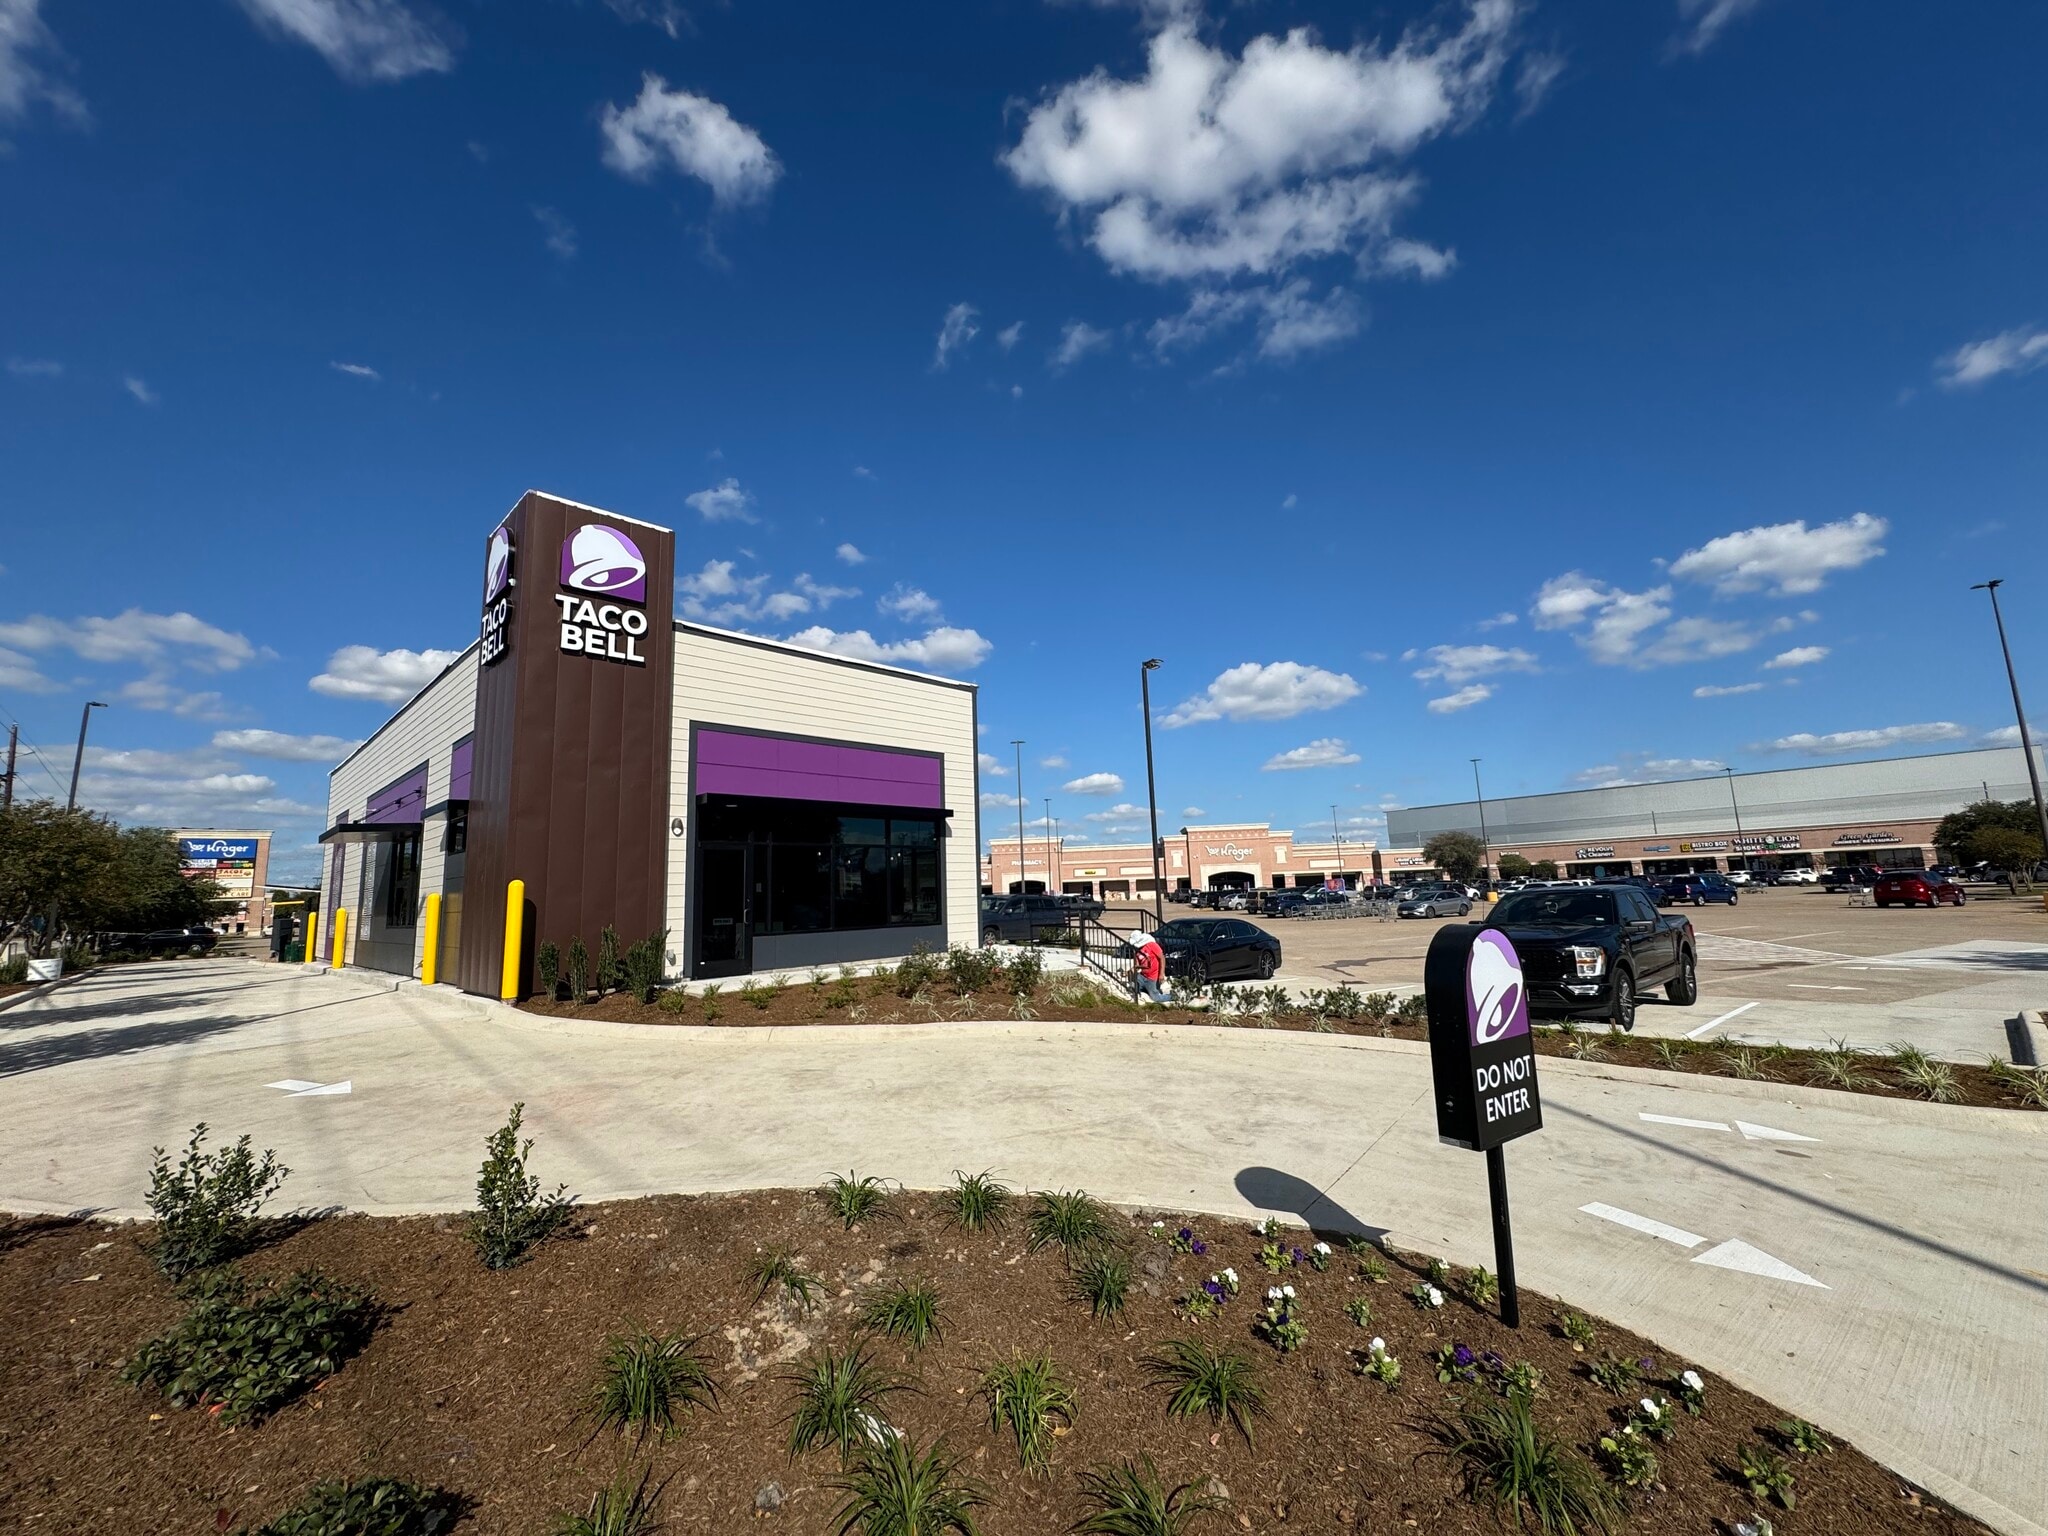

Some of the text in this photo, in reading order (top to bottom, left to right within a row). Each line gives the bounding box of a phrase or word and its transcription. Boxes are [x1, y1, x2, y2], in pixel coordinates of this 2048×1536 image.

[481, 598, 507, 639] TACO
[555, 593, 648, 635] TACO
[480, 627, 504, 666] BELL
[560, 623, 645, 663] BELL
[206, 840, 249, 858] Kroger
[1221, 843, 1254, 861] Kroger
[1476, 1055, 1531, 1092] DO NOT
[1485, 1088, 1531, 1123] ENTER
